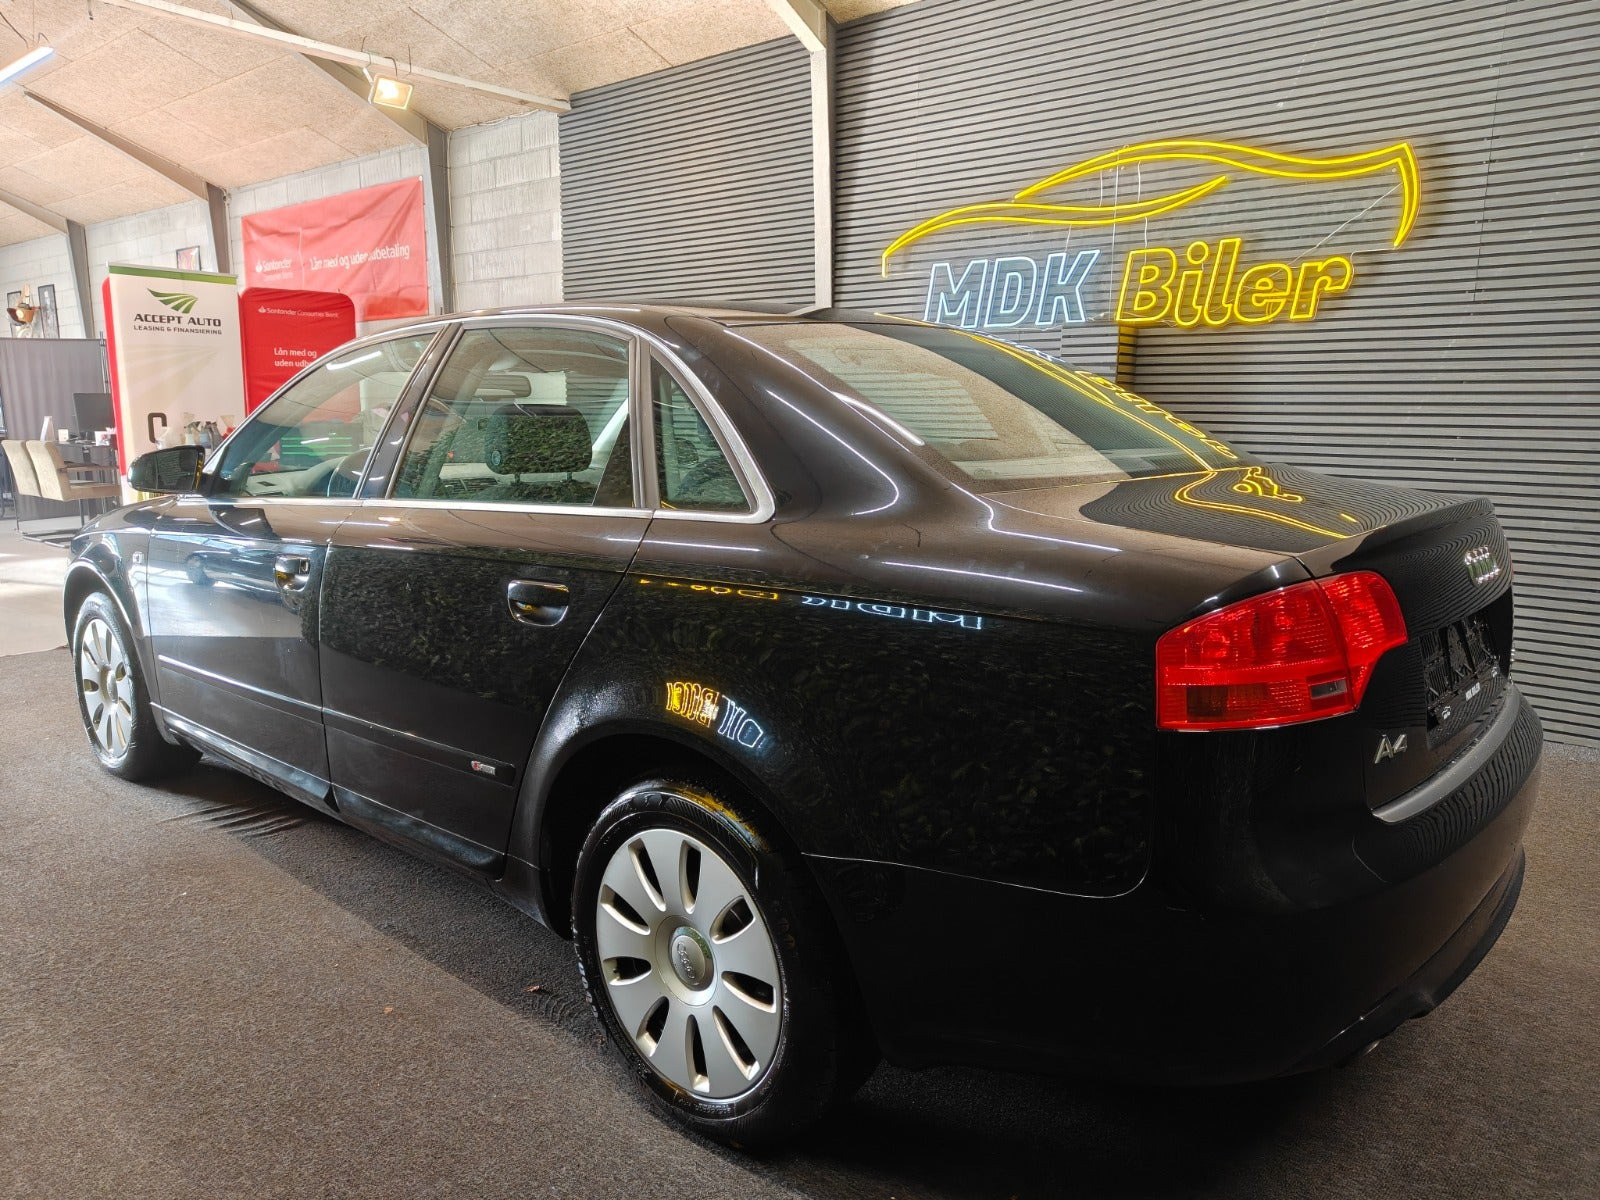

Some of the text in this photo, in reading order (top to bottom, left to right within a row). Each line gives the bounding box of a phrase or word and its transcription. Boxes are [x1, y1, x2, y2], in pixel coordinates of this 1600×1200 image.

[339, 255, 350, 269] og
[923, 237, 1354, 328] MDK Biler
[266, 307, 296, 316] Santander
[134, 313, 222, 327] ACCEPT AUTO
[133, 324, 165, 332] LEASING
[173, 327, 222, 335] FINANSIERING
[274, 347, 317, 358] Lån med og
[274, 359, 294, 367] uden
[1374, 733, 1408, 765] A4
